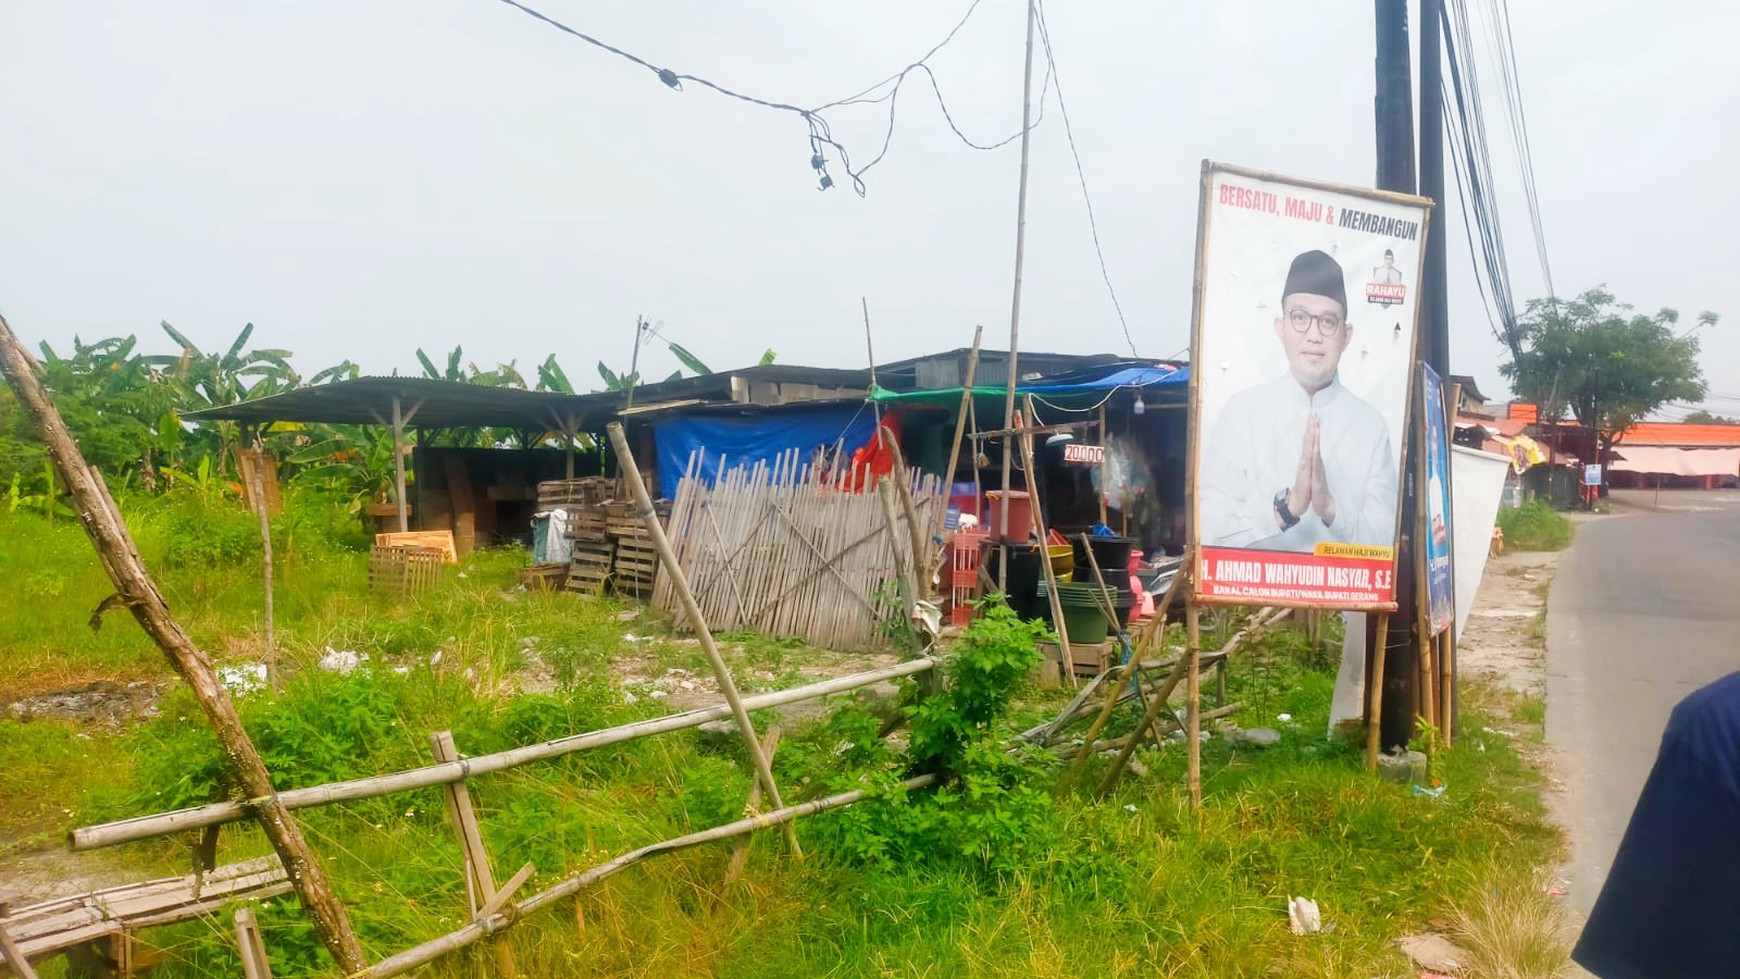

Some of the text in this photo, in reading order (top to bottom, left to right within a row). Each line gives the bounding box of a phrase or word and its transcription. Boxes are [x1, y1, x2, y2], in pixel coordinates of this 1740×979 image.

[1219, 184, 1418, 241] BERSATU, MAJU & MEMBANGUN
[1366, 284, 1405, 298] RAHAYU
[1215, 559, 1262, 583] AHMAD
[1264, 562, 1325, 587] WAHYUDIN
[1327, 567, 1372, 592] NASYAR,
[1213, 584, 1242, 596] BAKAL
[1242, 586, 1271, 597] CALON
[1350, 592, 1379, 602] SERANG
